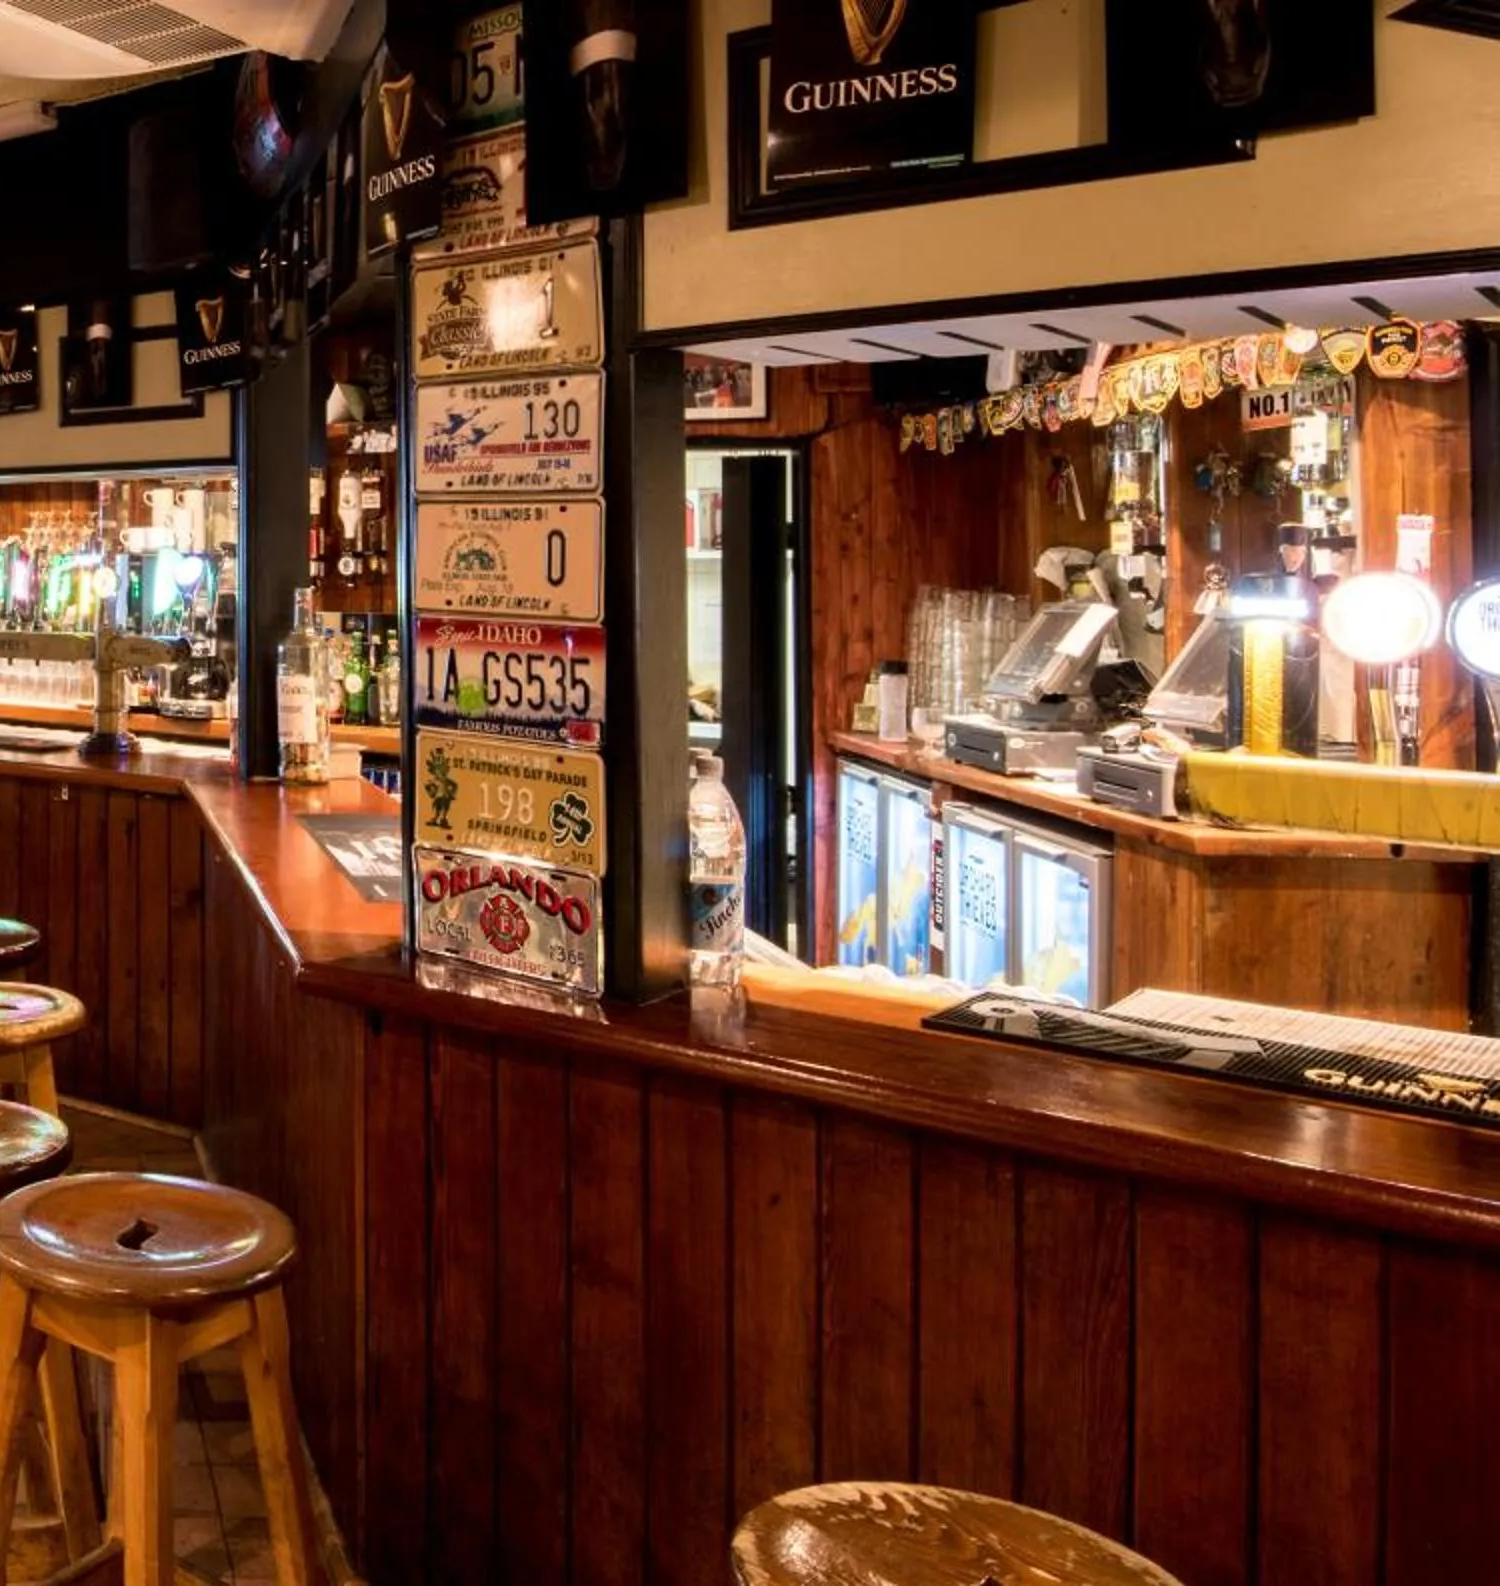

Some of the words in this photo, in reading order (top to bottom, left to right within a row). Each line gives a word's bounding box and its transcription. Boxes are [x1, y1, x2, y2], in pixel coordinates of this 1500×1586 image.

[468, 11, 523, 35] MISSO
[784, 64, 957, 113] GUINNESS
[368, 154, 436, 201] GUINNESS
[482, 259, 533, 280] ILLINOIS
[539, 277, 559, 339] 1
[183, 341, 241, 365] GUINNESS
[480, 382, 532, 399] ILLINOIS
[1249, 391, 1290, 420] NO.1
[524, 399, 581, 440] 130
[424, 445, 458, 463] USAF
[461, 474, 490, 487] LAND
[506, 472, 552, 488] LINCOLN
[481, 507, 532, 521] ILLINOIS
[547, 529, 566, 587] 0
[459, 594, 489, 608] LAND
[505, 595, 551, 610] LINCOLN
[479, 624, 542, 645] IDAHO
[425, 646, 460, 703] 1A
[483, 651, 591, 716] GS535
[469, 760, 521, 779] PATRICK'S
[523, 766, 543, 781] DAY
[545, 769, 588, 788] PARADE
[479, 782, 534, 825] 198
[466, 819, 548, 843] SPRINGFIELD
[422, 865, 592, 936] ORLANDO
[426, 918, 473, 942] LOCAL
